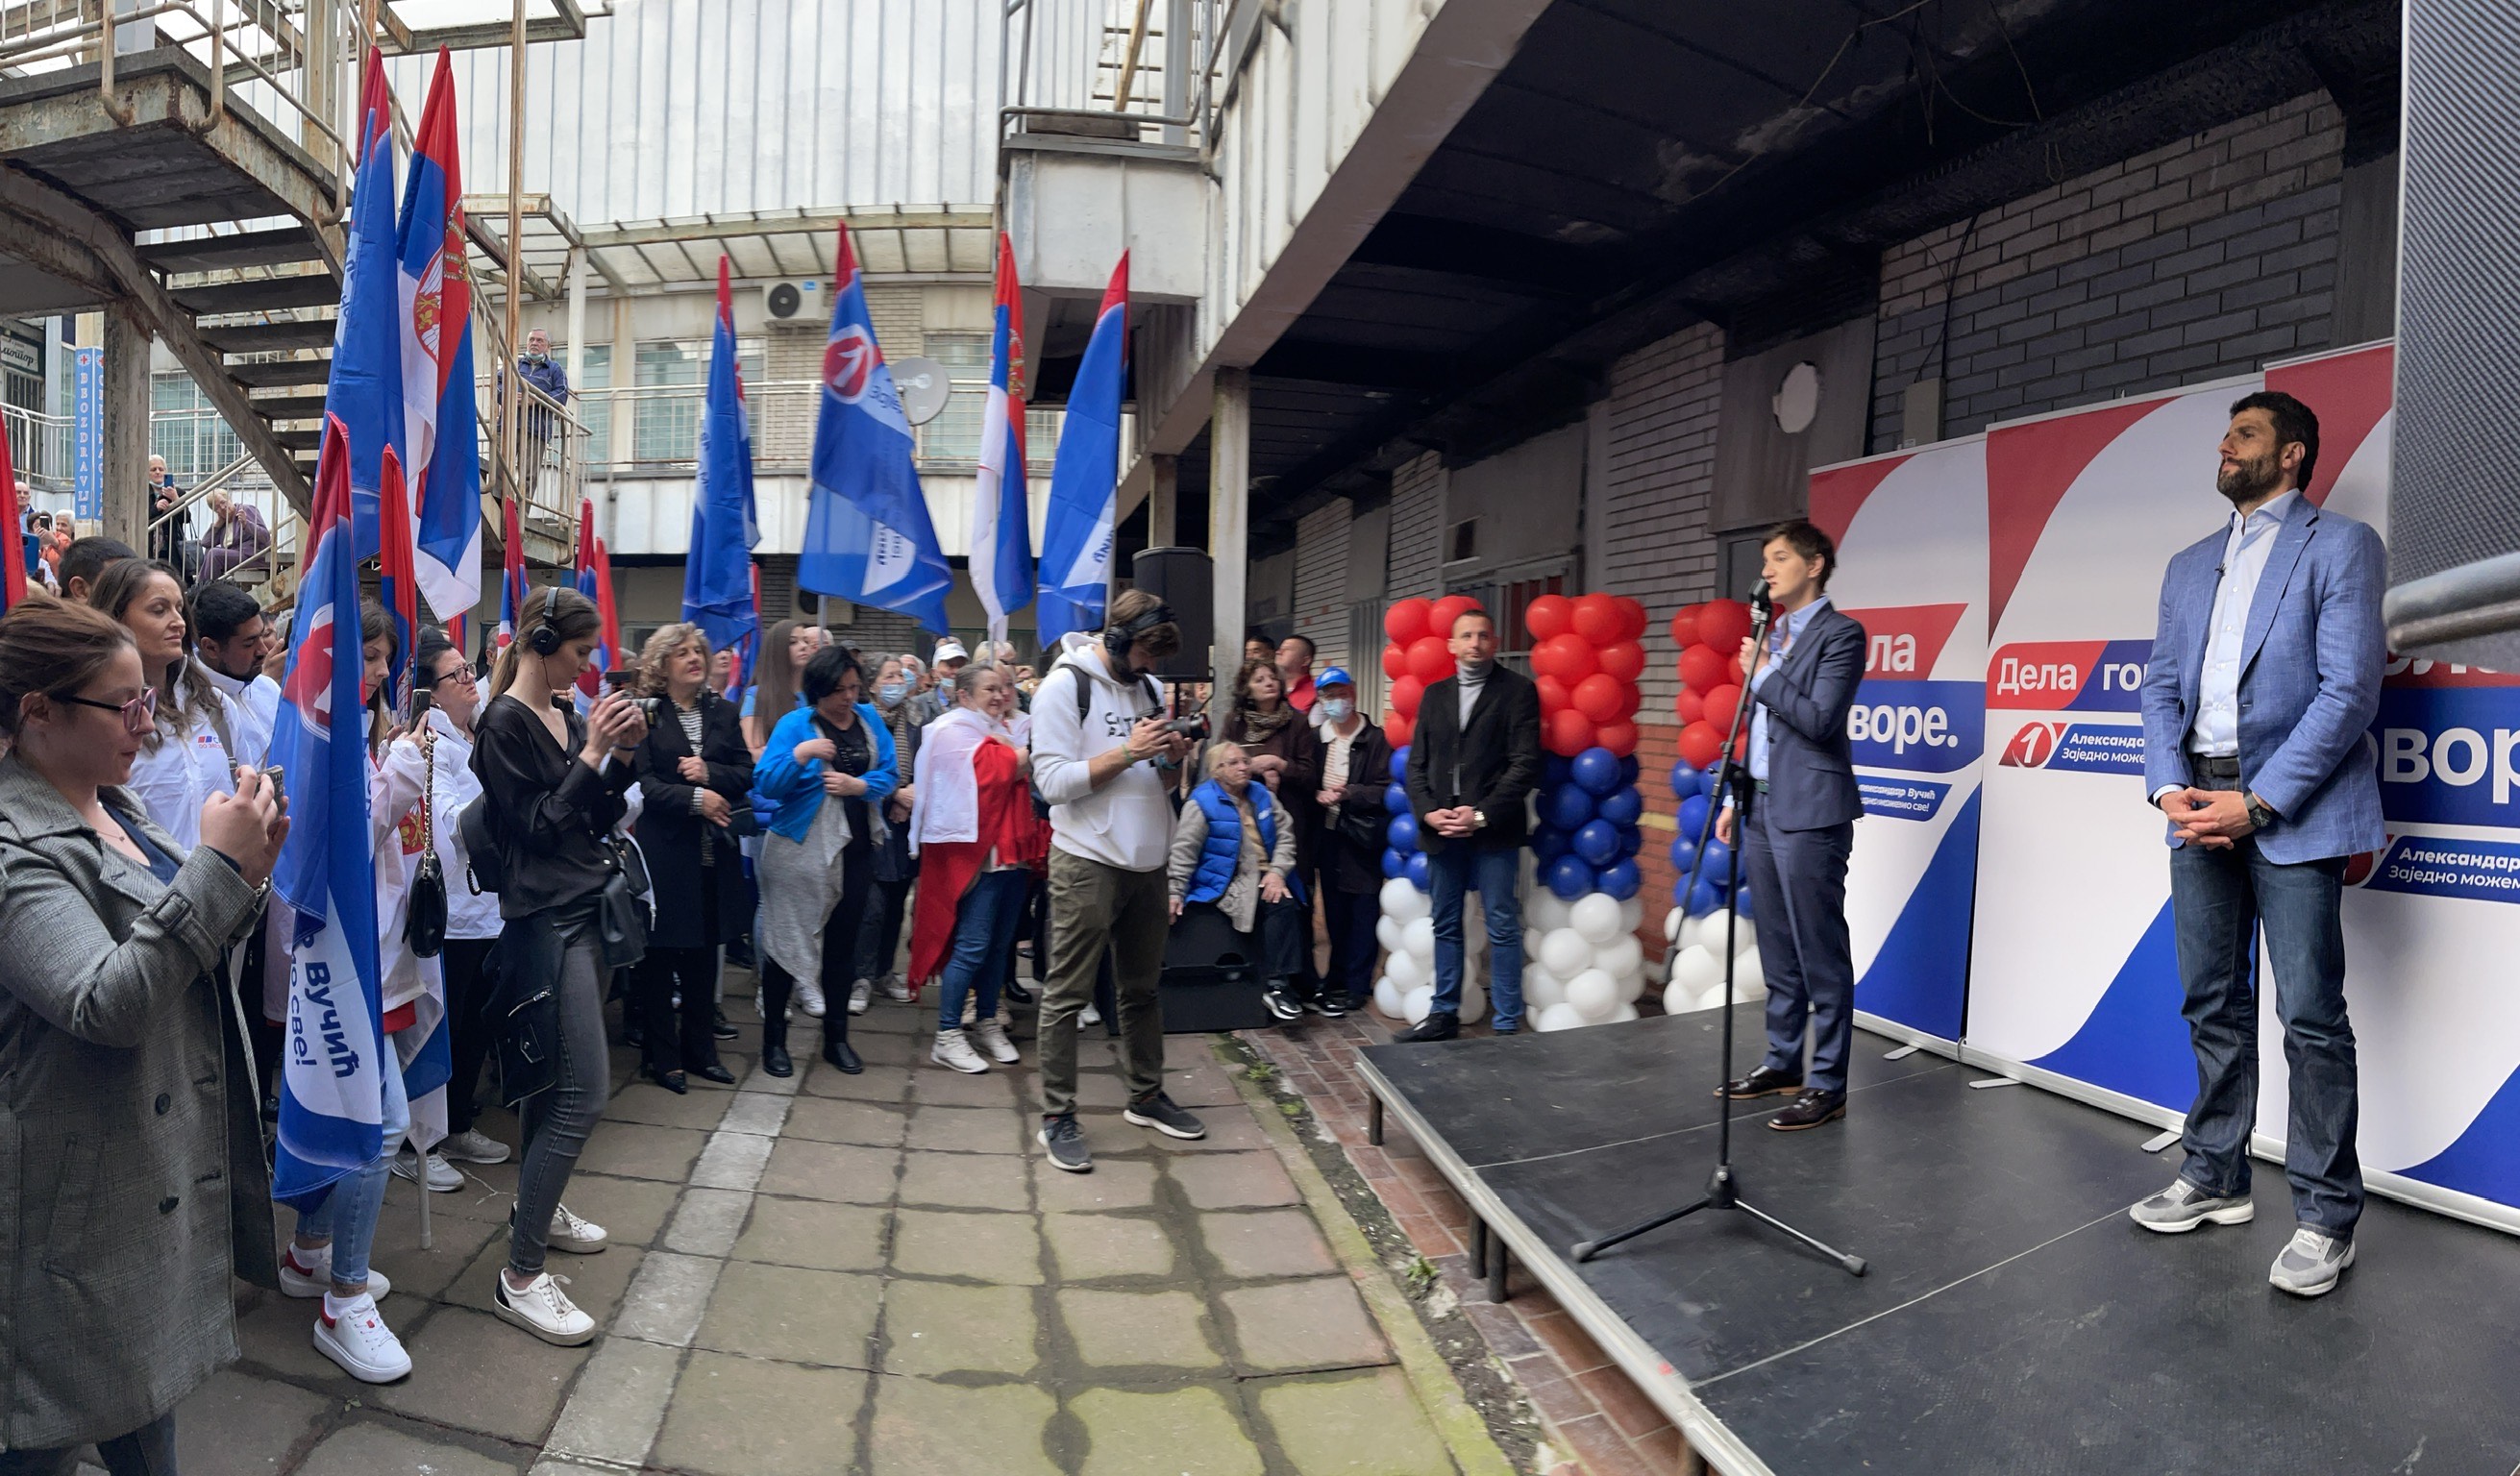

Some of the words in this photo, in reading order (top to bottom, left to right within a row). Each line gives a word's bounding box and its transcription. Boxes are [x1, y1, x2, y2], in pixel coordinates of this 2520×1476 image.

[78, 372, 89, 516] BEOZDRAVLJE
[1865, 633, 1916, 672] ла
[1996, 657, 2078, 696] Дела
[1846, 704, 1959, 754] воре.
[2069, 732, 2145, 749] Александа
[2062, 748, 2110, 762] Заједно
[2111, 752, 2145, 764] може
[1907, 787, 1936, 800] Вучић
[2388, 865, 2458, 884] Заједно
[2460, 874, 2520, 890] можем
[2399, 847, 2520, 873] Александар
[291, 995, 317, 1067] све!
[305, 961, 360, 1078] Вучић
